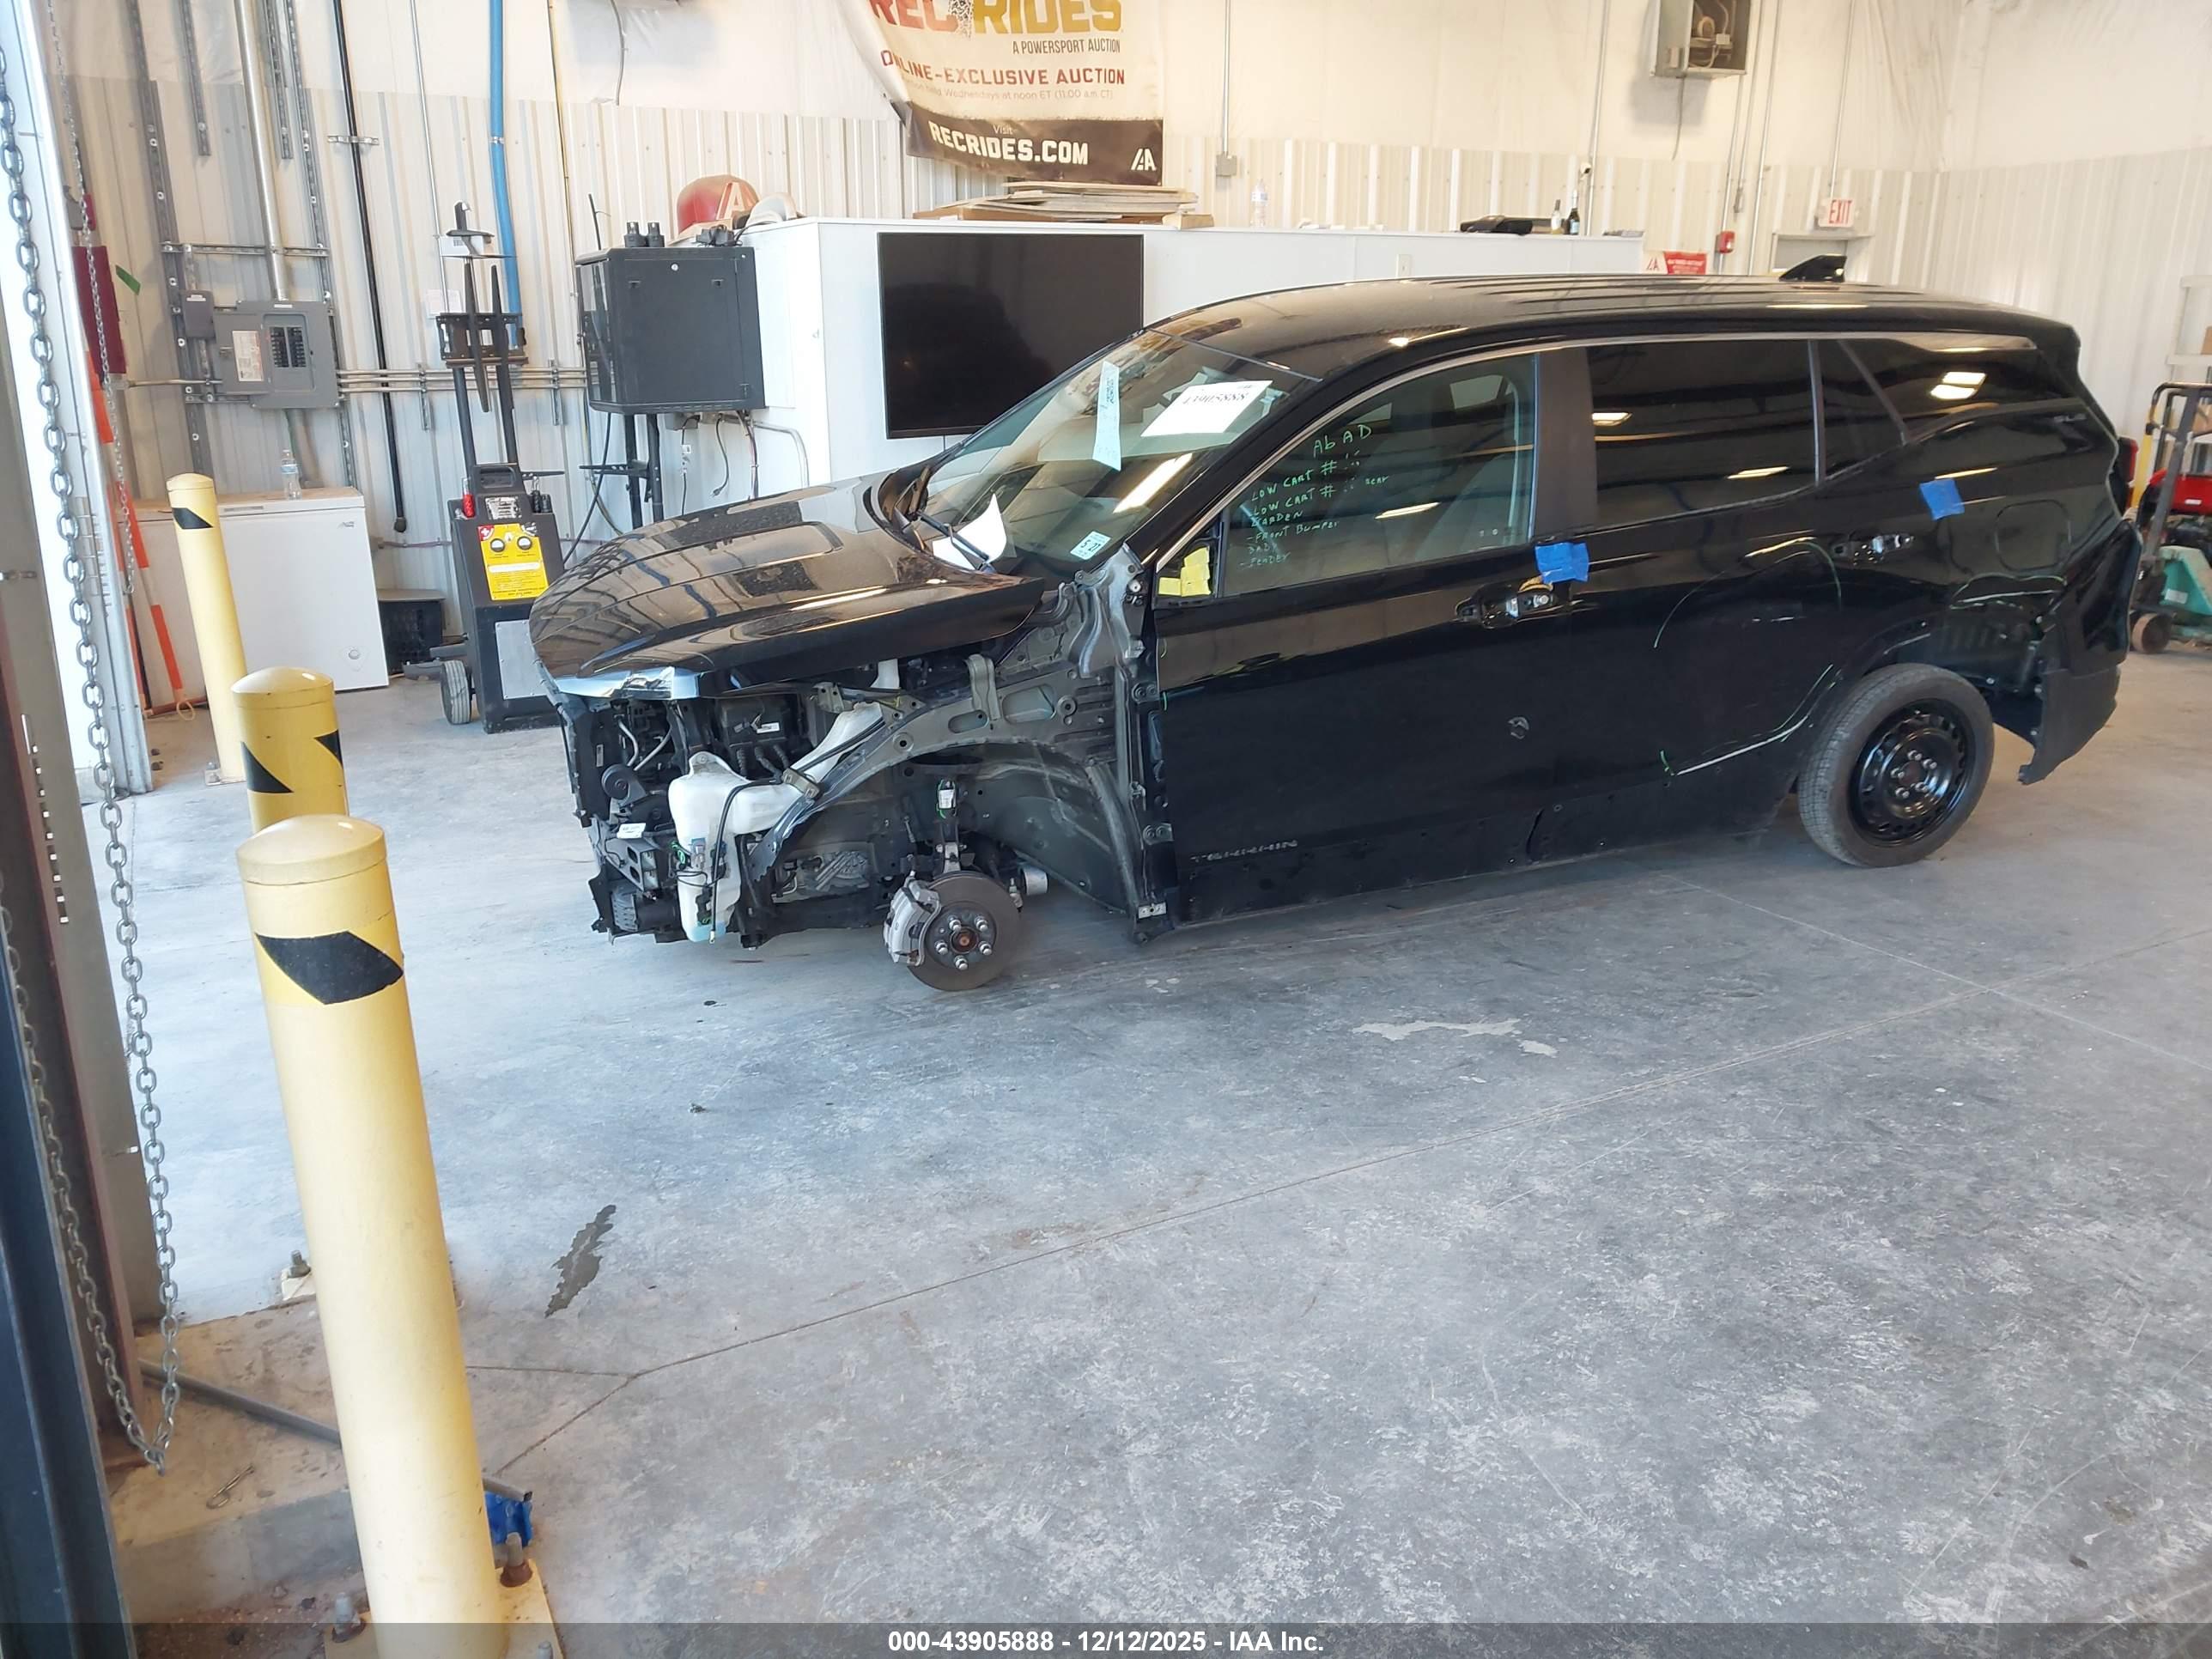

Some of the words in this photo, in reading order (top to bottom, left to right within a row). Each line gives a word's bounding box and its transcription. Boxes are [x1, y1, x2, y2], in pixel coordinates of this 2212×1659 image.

[1012, 41, 1020, 54] A
[1021, 39, 1085, 54] POWERSPORT
[1088, 39, 1121, 52] AUCTION
[880, 50, 1048, 85] ONLINE-EXCLUSIVE
[1056, 68, 1125, 85] AUCTION
[1039, 90, 1052, 99] ET
[928, 120, 1088, 165] RECRIDES.COM
[1828, 199, 1853, 225] EXIT
[1252, 483, 1277, 501] LOW
[1283, 469, 1314, 488] CART
[1254, 500, 1279, 516] LOW
[1285, 488, 1316, 507] CART
